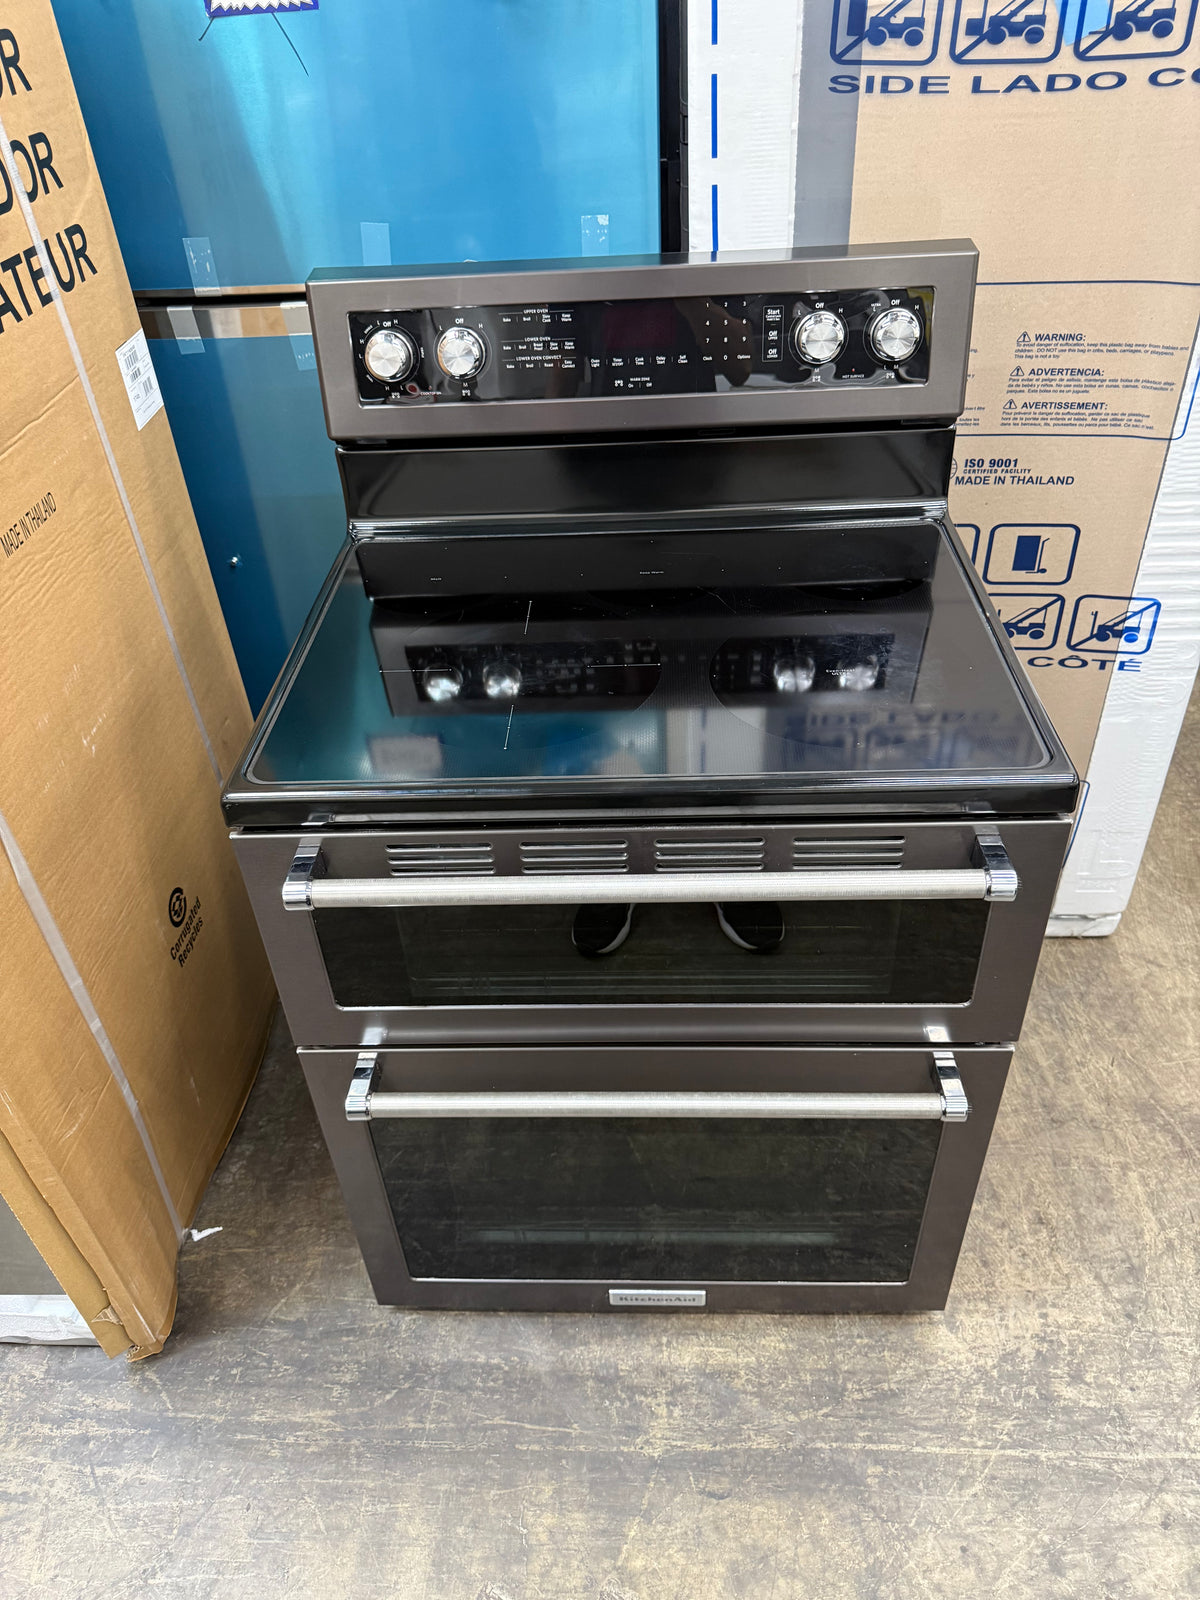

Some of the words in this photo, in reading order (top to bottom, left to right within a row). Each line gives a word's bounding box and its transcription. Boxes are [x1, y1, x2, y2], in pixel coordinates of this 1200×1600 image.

[828, 74, 950, 95] SIDE
[971, 71, 1128, 94] LADO
[1148, 67, 1200, 88] C
[1034, 333, 1087, 342] WARNING:
[1028, 368, 1105, 376] ADVERTENCIA:
[1021, 401, 1108, 410] AVERTISSEMENT:
[964, 458, 985, 469] ISO
[988, 458, 1018, 468] 9001
[954, 476, 991, 485] MADE
[993, 476, 1006, 485] IN
[1009, 475, 1075, 486] THAILAND
[0, 523, 24, 558] MADE
[18, 515, 32, 541] IN
[25, 492, 57, 533] THAILAND
[1027, 655, 1143, 672] CÔTÉ
[170, 895, 201, 960] Corrugated
[178, 916, 203, 968] Recycles
